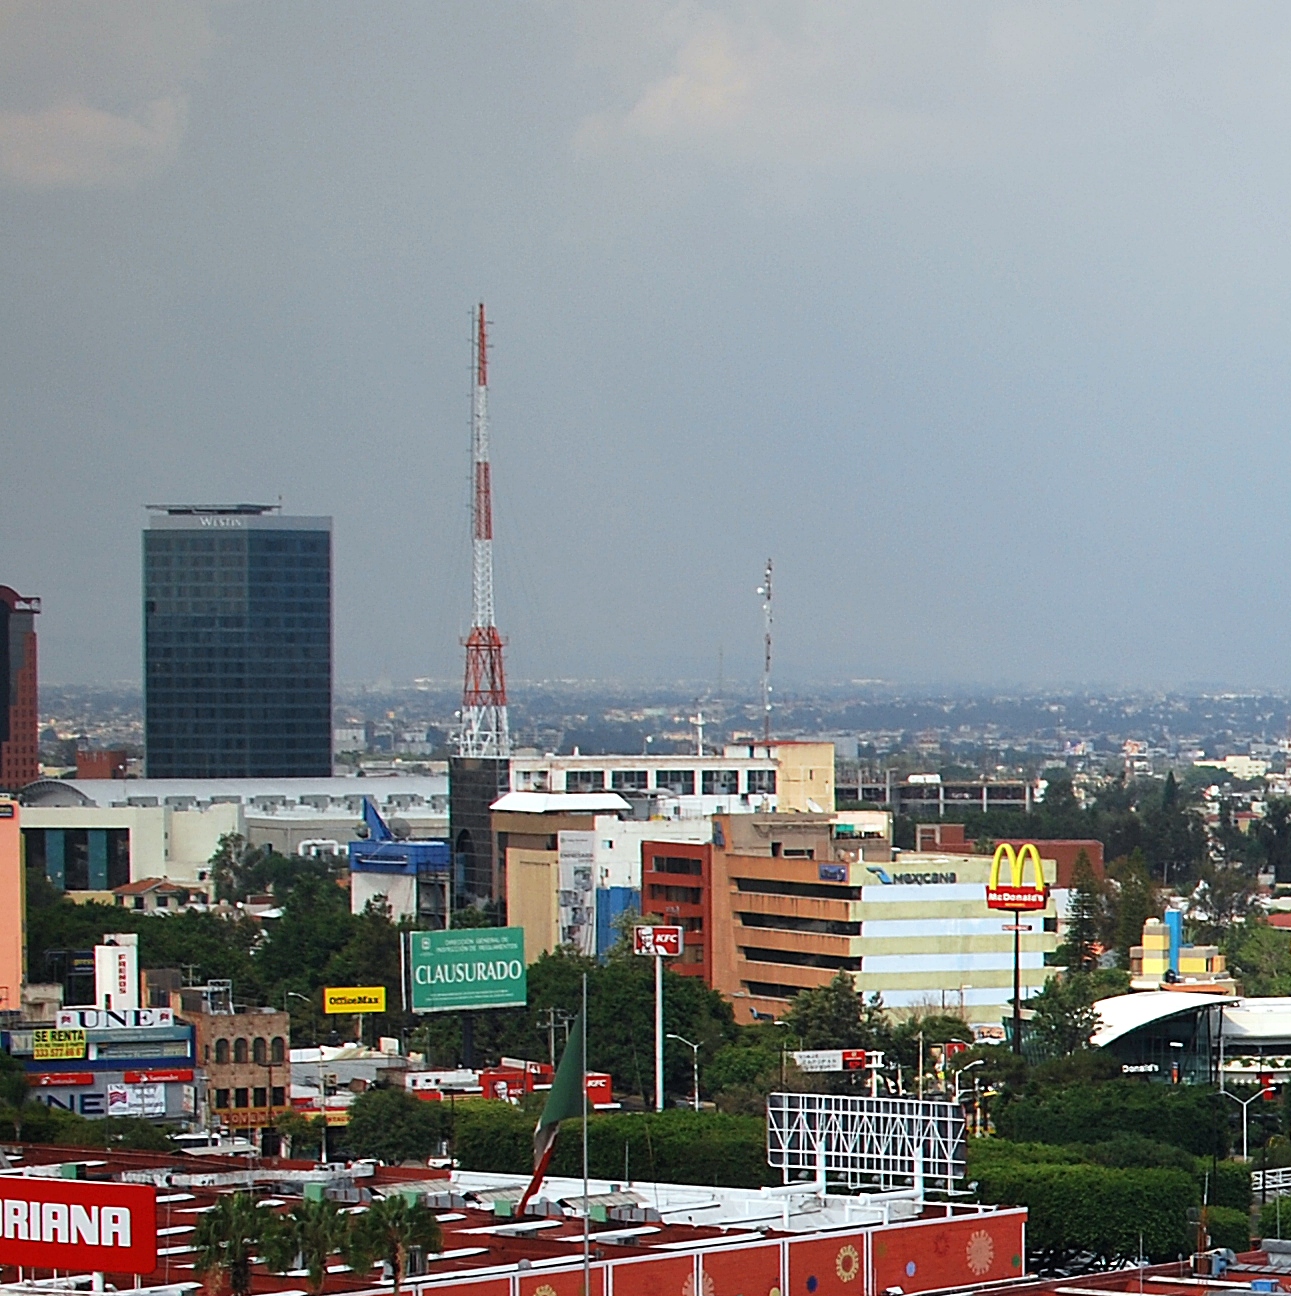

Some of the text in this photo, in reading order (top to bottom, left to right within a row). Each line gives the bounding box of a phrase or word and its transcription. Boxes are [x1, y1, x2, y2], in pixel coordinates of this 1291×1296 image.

[988, 892, 1045, 902] McDonald's
[655, 934, 677, 943] KFC
[415, 960, 522, 985] CLAUSURADO
[329, 995, 379, 1005] OfficeMax
[78, 1010, 155, 1029] UNE
[35, 1031, 48, 1042] SE
[51, 1029, 84, 1041] RENTA
[587, 1080, 606, 1088] KFC
[509, 1088, 524, 1096] KFC
[0, 1198, 131, 1247] RIANA
